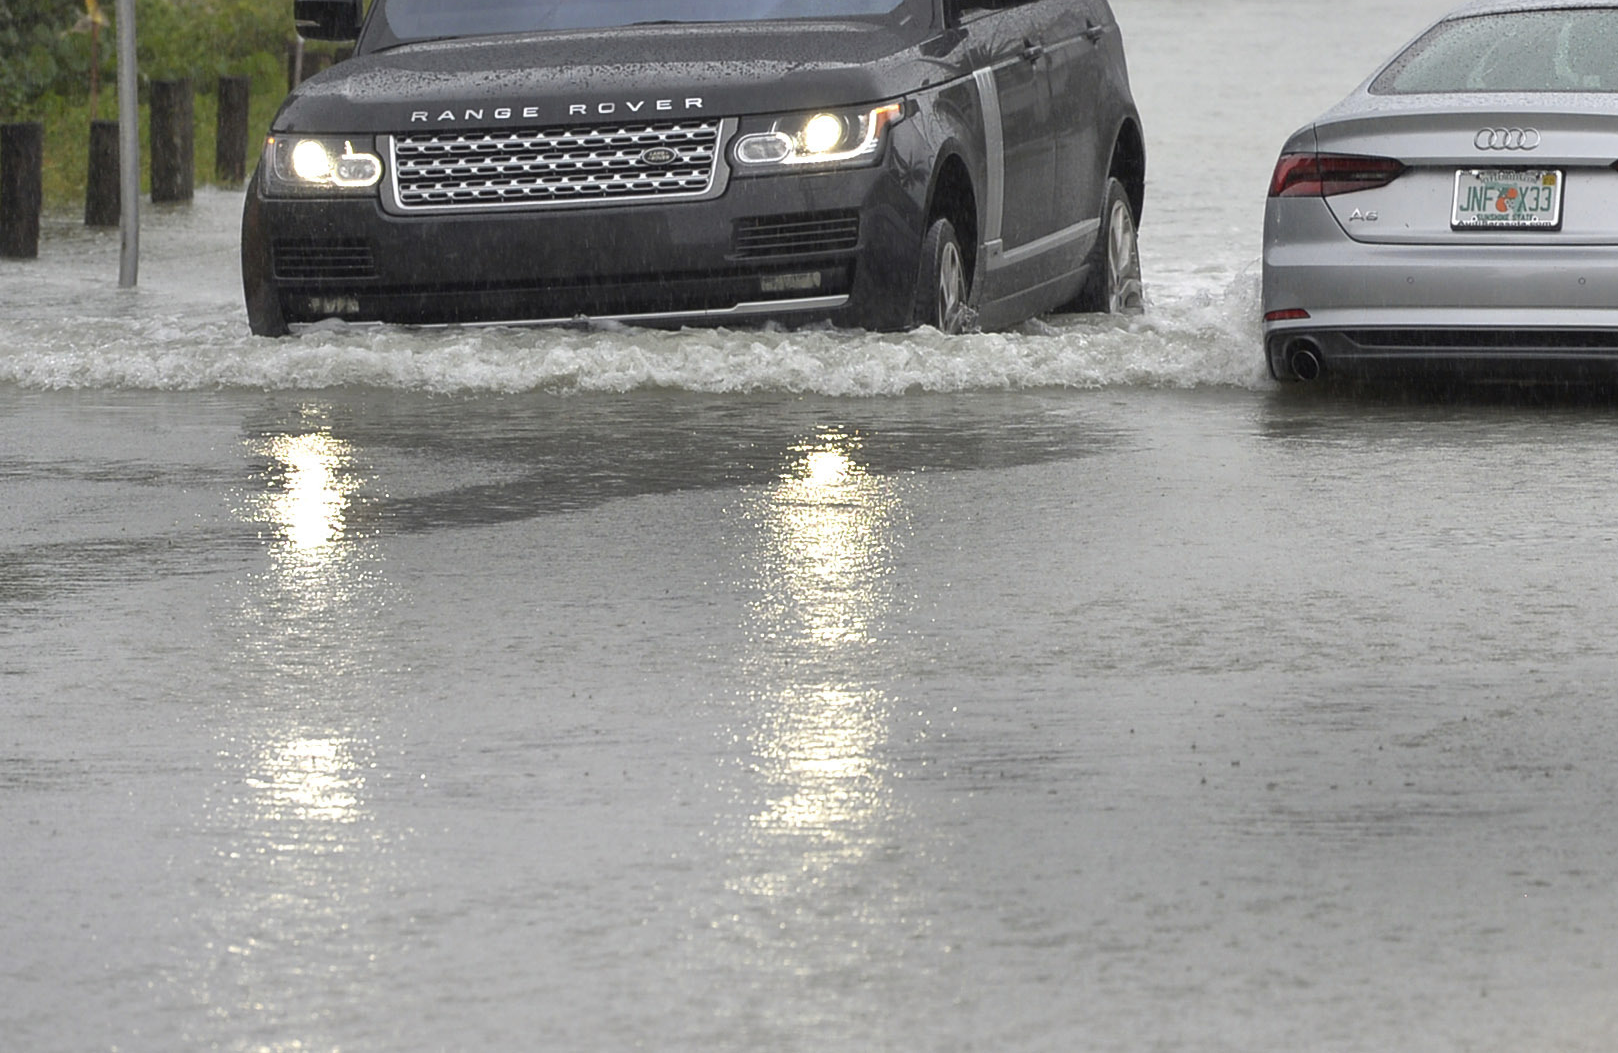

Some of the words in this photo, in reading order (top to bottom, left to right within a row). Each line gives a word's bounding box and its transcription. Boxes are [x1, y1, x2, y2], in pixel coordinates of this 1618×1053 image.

[410, 106, 540, 122] RANGE
[568, 97, 704, 116] ROVER
[1459, 185, 1494, 212] JNF
[1517, 185, 1552, 212] X33
